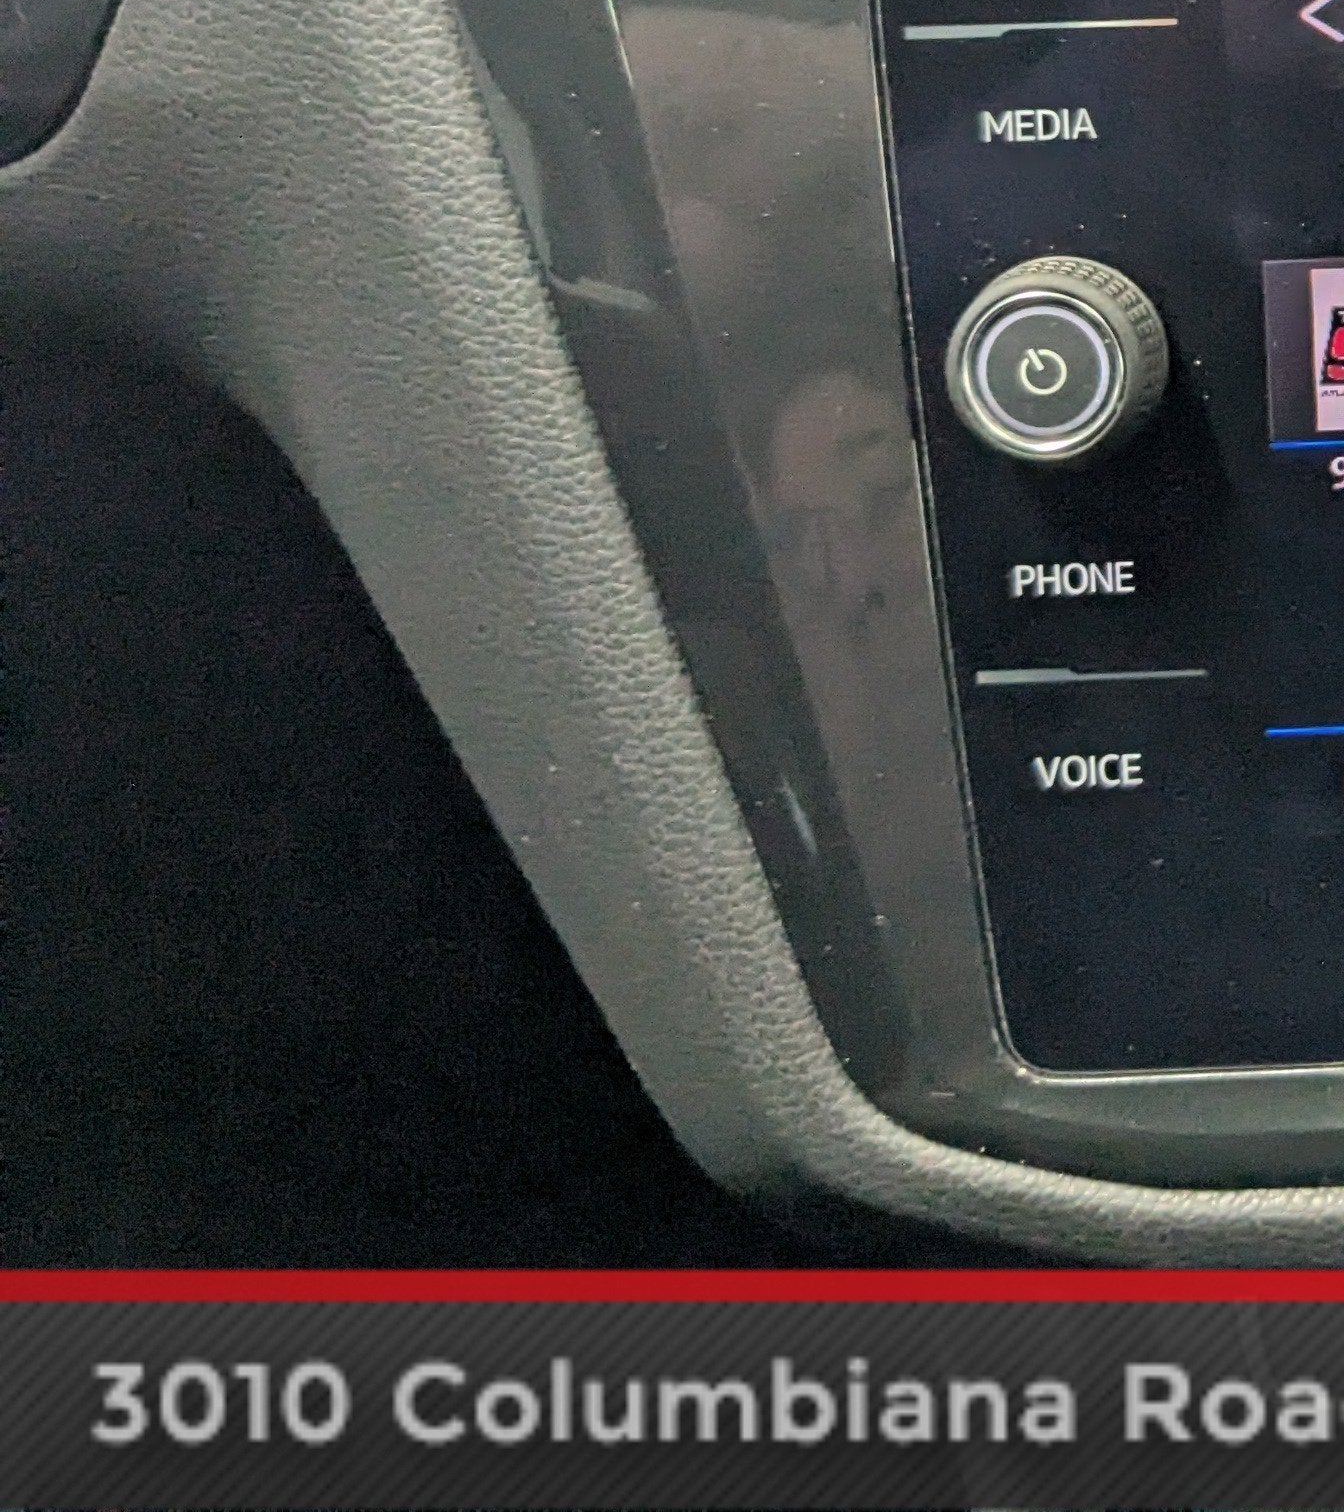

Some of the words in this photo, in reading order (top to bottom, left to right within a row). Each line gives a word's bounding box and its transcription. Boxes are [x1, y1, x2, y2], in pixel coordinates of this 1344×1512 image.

[979, 107, 1099, 143] MEDIA
[1010, 561, 1136, 597] PHONE
[1031, 752, 1144, 789] VOICE
